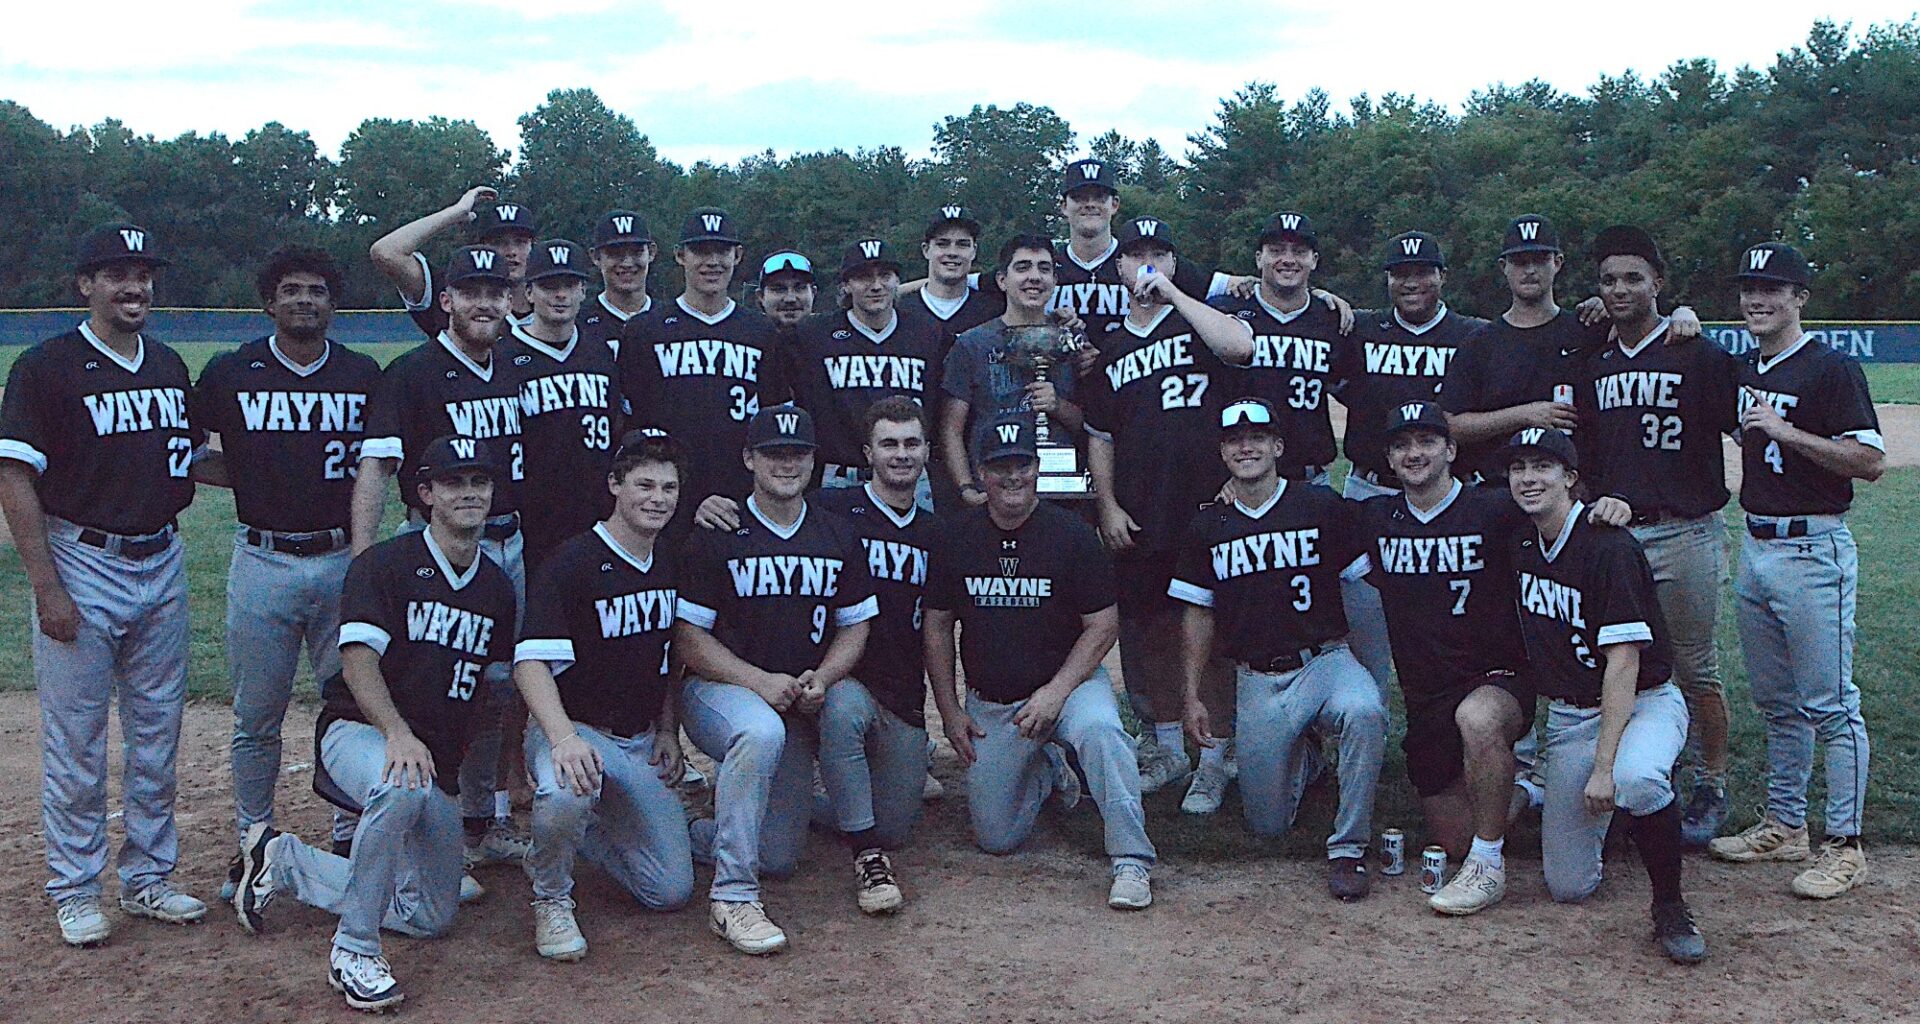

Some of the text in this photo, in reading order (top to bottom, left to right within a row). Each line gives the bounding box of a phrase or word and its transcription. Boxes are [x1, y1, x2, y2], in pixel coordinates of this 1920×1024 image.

[1081, 163, 1100, 179] W
[496, 205, 517, 221] W
[613, 216, 633, 234] W
[702, 214, 722, 231] W
[942, 206, 961, 218] W
[1280, 214, 1301, 230] W
[120, 229, 144, 251] W
[1136, 220, 1158, 236] W
[1518, 222, 1539, 240] W
[471, 250, 495, 270] W
[549, 246, 569, 265] W
[859, 240, 881, 258] W
[1401, 238, 1422, 255] W
[1750, 249, 1773, 269] W
[654, 340, 762, 382] WAYNE
[1105, 333, 1194, 392] WAYNE
[1252, 335, 1331, 373] AYNE
[1364, 342, 1457, 376] WAYN
[824, 355, 926, 391] WAYNE
[1161, 373, 1209, 410] 27
[1288, 376, 1323, 410] 33
[82, 388, 190, 436] WAYNE
[237, 391, 367, 432] WAYNE
[775, 414, 799, 434] W
[1401, 403, 1423, 420] W
[581, 414, 611, 449] 39
[996, 424, 1020, 443] W
[1521, 427, 1545, 444] W
[1641, 413, 1683, 450] 32
[450, 438, 476, 459] W
[1764, 440, 1784, 473] 4
[861, 538, 929, 588] AYN
[999, 557, 1020, 577] W
[1210, 528, 1320, 581] WAYNE
[1378, 535, 1484, 574] WAYNE
[727, 555, 844, 598] WAYNE
[965, 577, 1052, 597] WAYNE
[975, 597, 1039, 607] BASEBALL
[1290, 575, 1312, 611] 3
[1450, 579, 1471, 615] 7
[595, 589, 677, 638] WAYN
[811, 604, 827, 644] 9
[407, 601, 495, 656] WAYNE
[447, 659, 482, 702] 15
